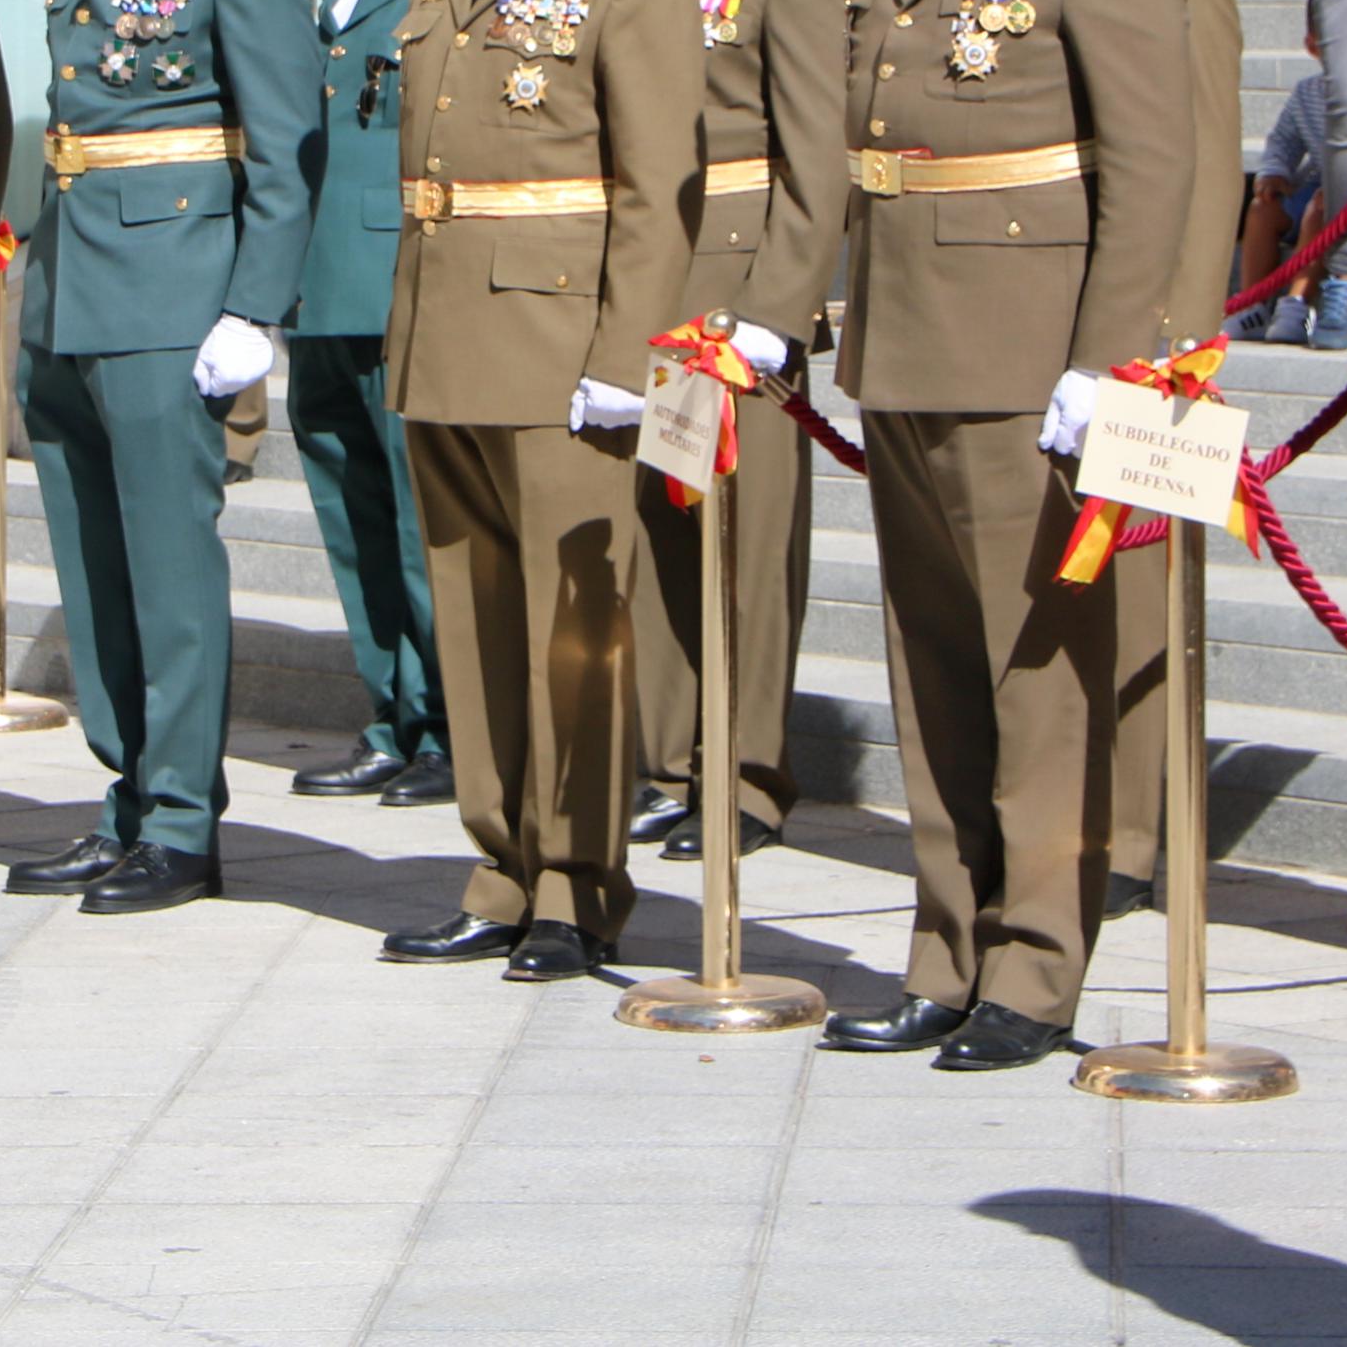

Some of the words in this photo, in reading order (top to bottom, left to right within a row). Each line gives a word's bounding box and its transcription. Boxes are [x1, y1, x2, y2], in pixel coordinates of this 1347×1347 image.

[1103, 420, 1231, 463] SUBDELEGADO
[1148, 453, 1172, 470] DE
[1119, 467, 1196, 499] DEFENSA
